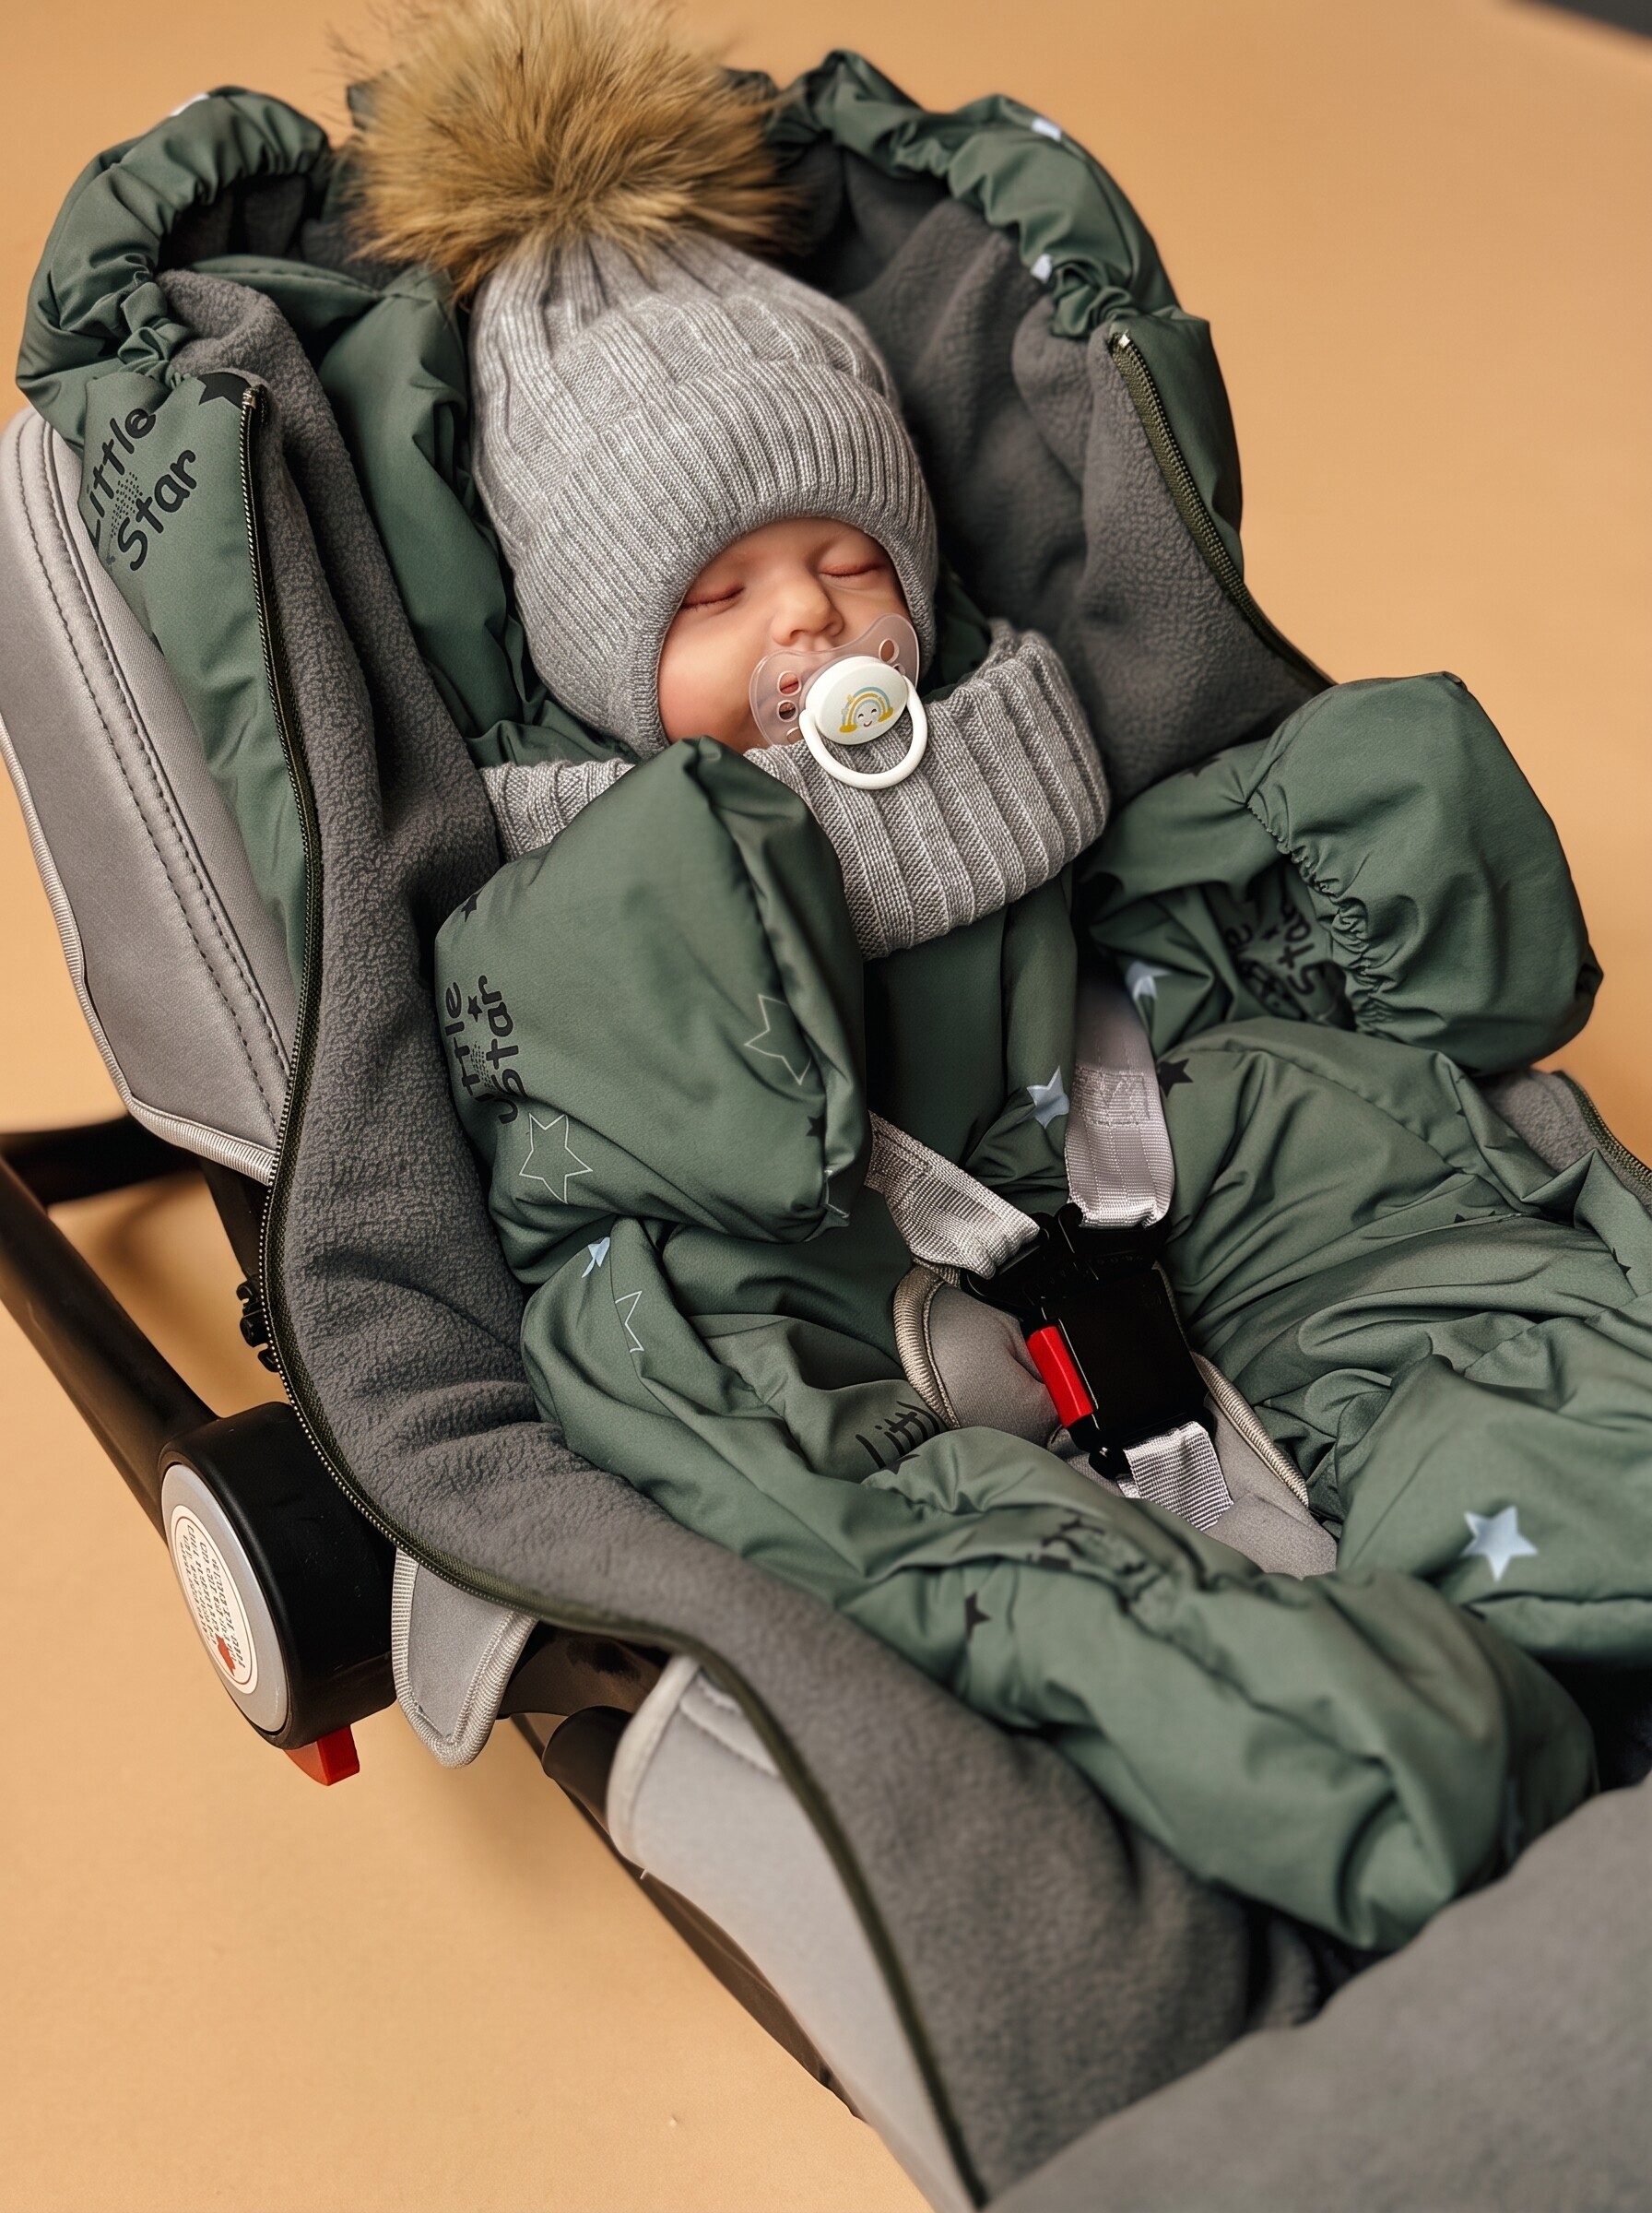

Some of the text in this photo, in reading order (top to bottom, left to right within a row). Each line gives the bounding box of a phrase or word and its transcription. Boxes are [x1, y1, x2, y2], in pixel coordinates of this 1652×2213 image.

[117, 449, 197, 572] Star
[478, 975, 527, 1125] Star
[856, 1401, 940, 1469] Littl
